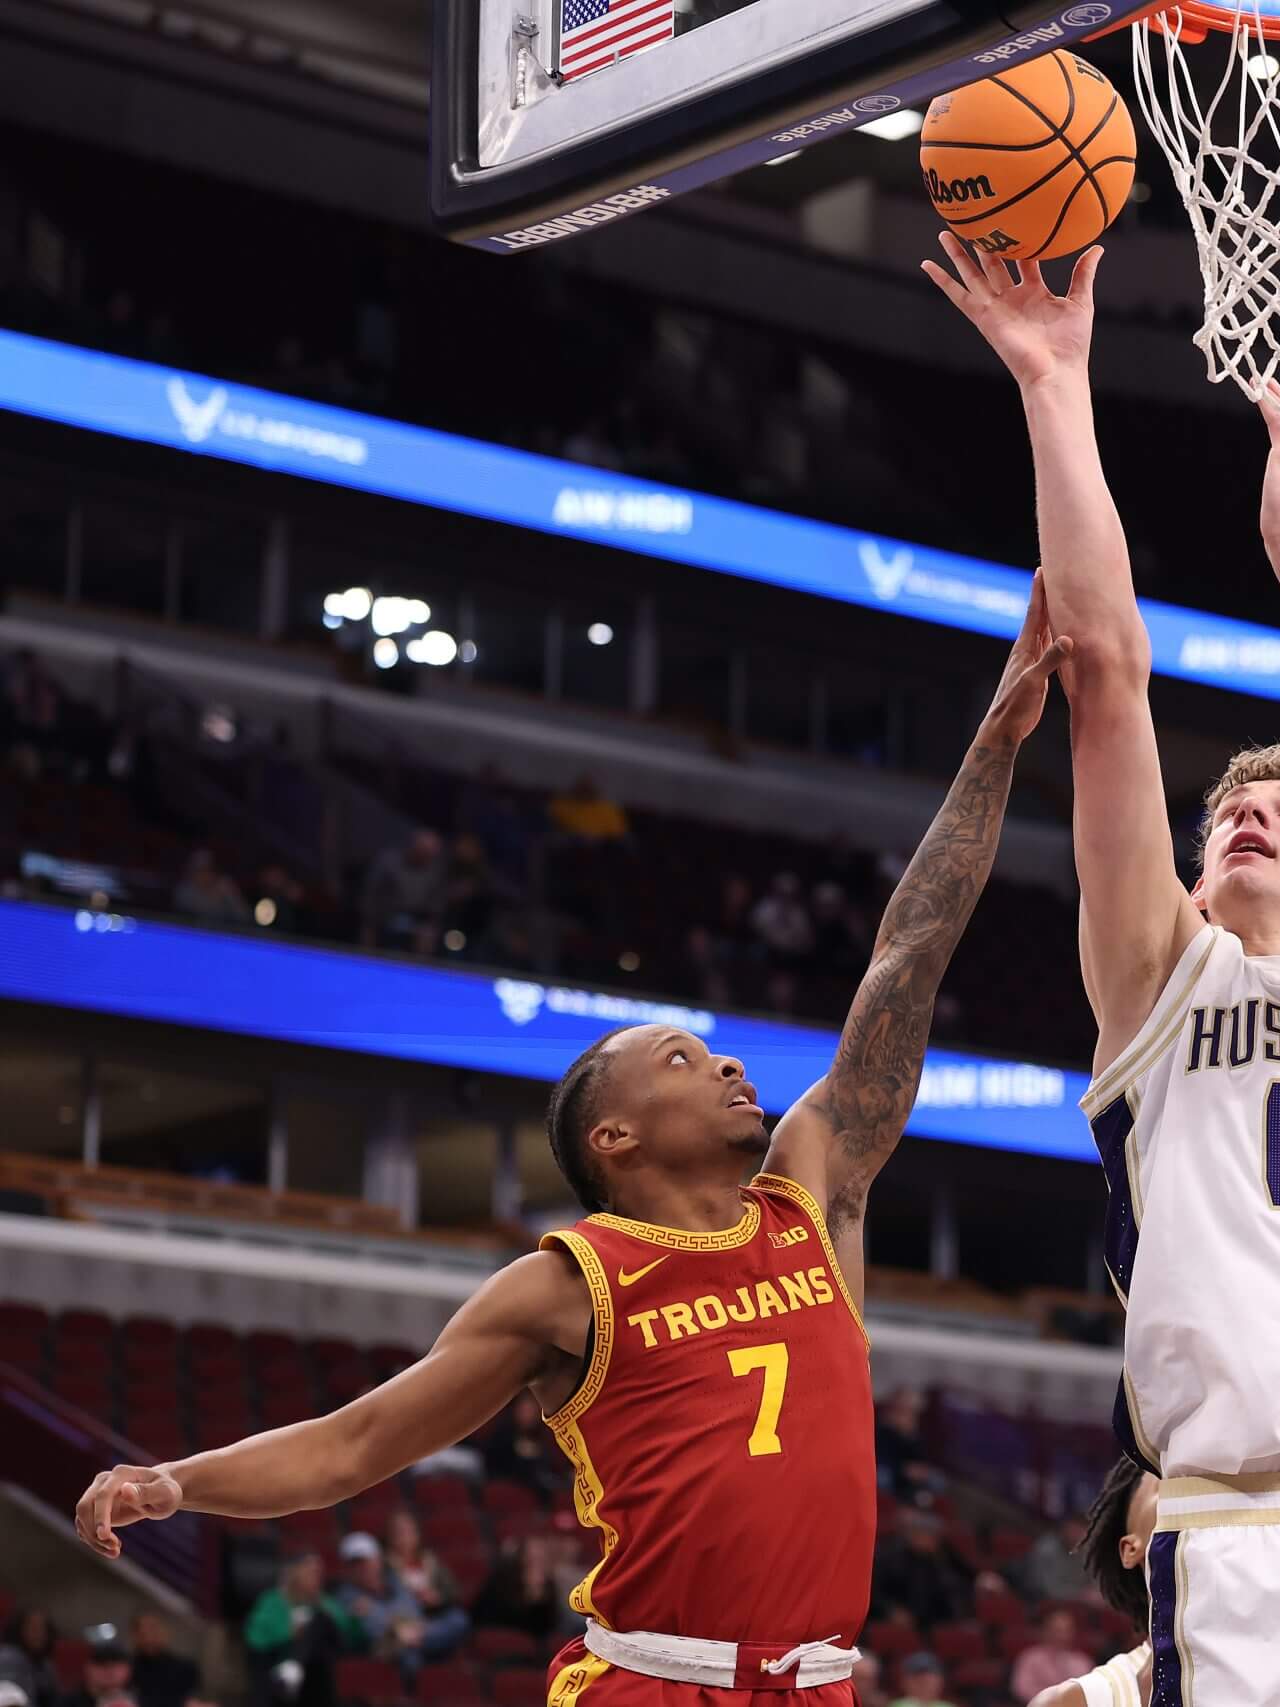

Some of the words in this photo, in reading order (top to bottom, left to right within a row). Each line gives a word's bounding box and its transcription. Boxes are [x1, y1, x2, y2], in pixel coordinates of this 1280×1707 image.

[972, 22, 1064, 63] Allstate
[771, 108, 856, 142] Allstate
[488, 185, 671, 248] #B1GMBBT
[628, 1266, 834, 1348] TROJANS
[726, 1342, 790, 1457] 7
